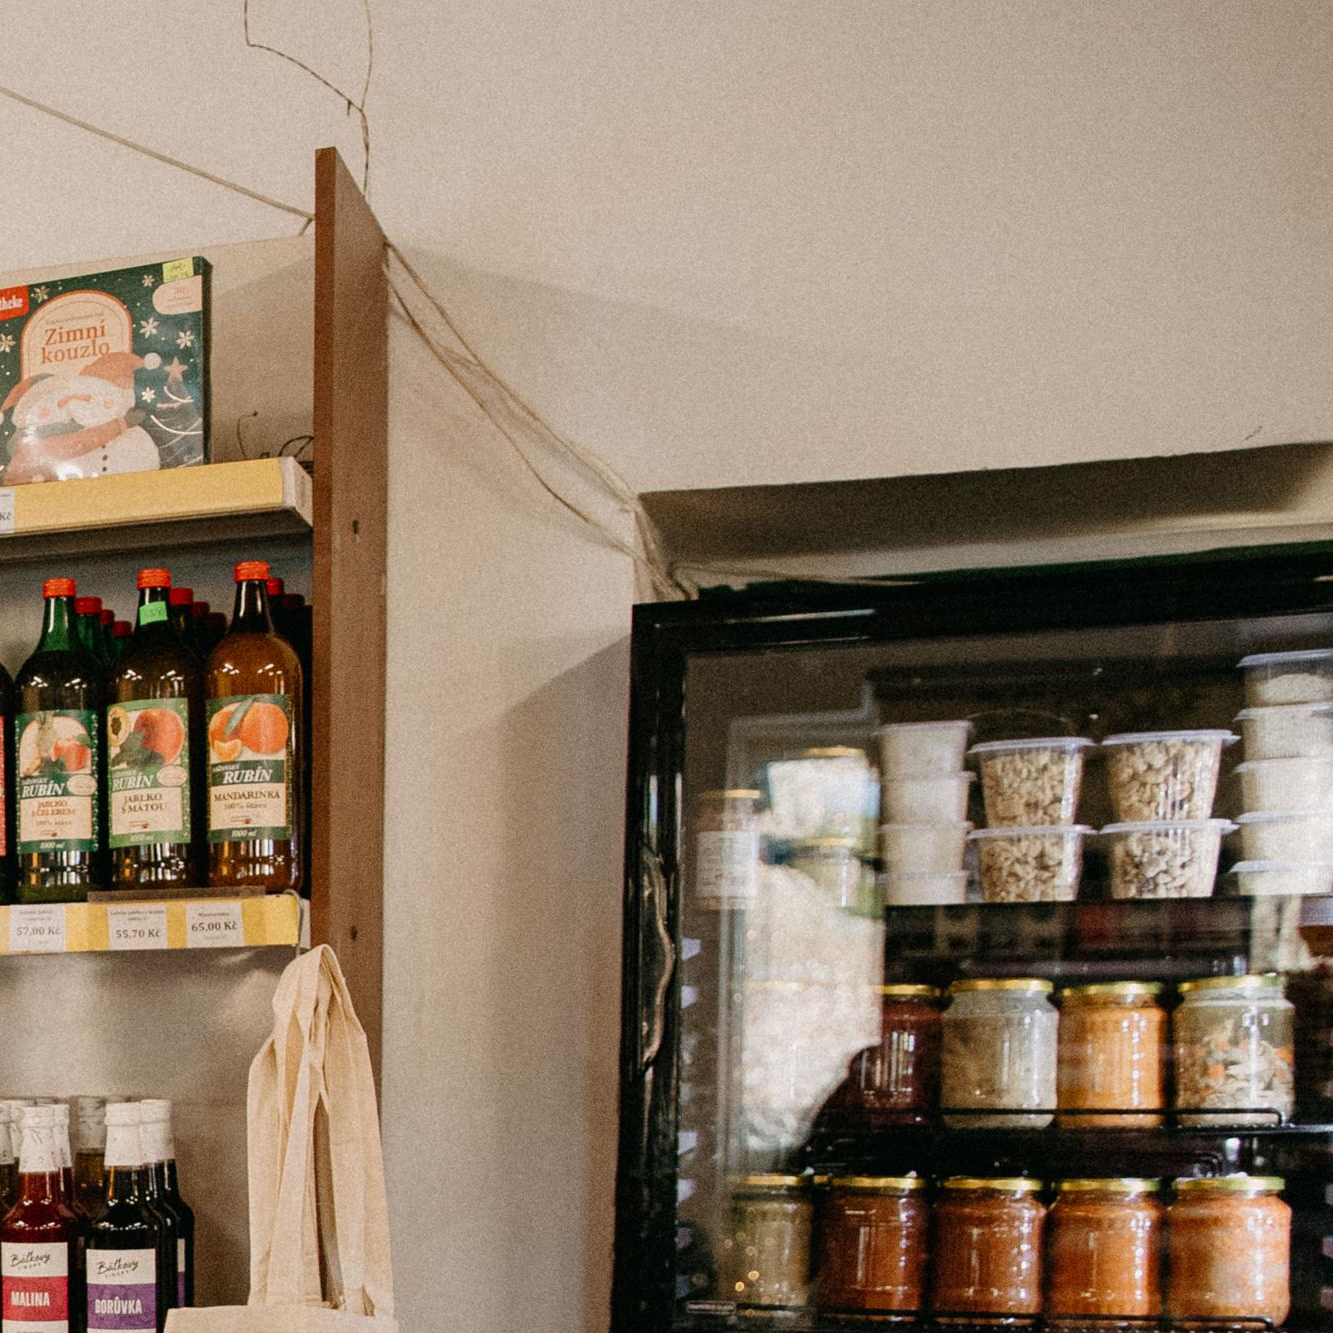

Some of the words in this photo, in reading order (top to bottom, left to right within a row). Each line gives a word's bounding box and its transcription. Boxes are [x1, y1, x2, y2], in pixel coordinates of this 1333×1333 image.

[44, 320, 107, 346] Zimní
[41, 339, 110, 364] kouzlo
[113, 773, 154, 790] RUBÍN
[223, 768, 273, 784] RUBÍN
[22, 782, 65, 798] RUBÍN
[214, 789, 281, 801] MANDARINKA
[124, 793, 163, 804] JABLKO
[17, 926, 44, 937] 57,00
[47, 925, 61, 936] Kč
[115, 928, 144, 939] 55,70
[147, 927, 161, 938] Kč
[191, 921, 220, 932] 65,00
[222, 920, 237, 931] Kč
[10, 1291, 50, 1307] MALINA
[94, 1297, 142, 1314] BORŮVKA
